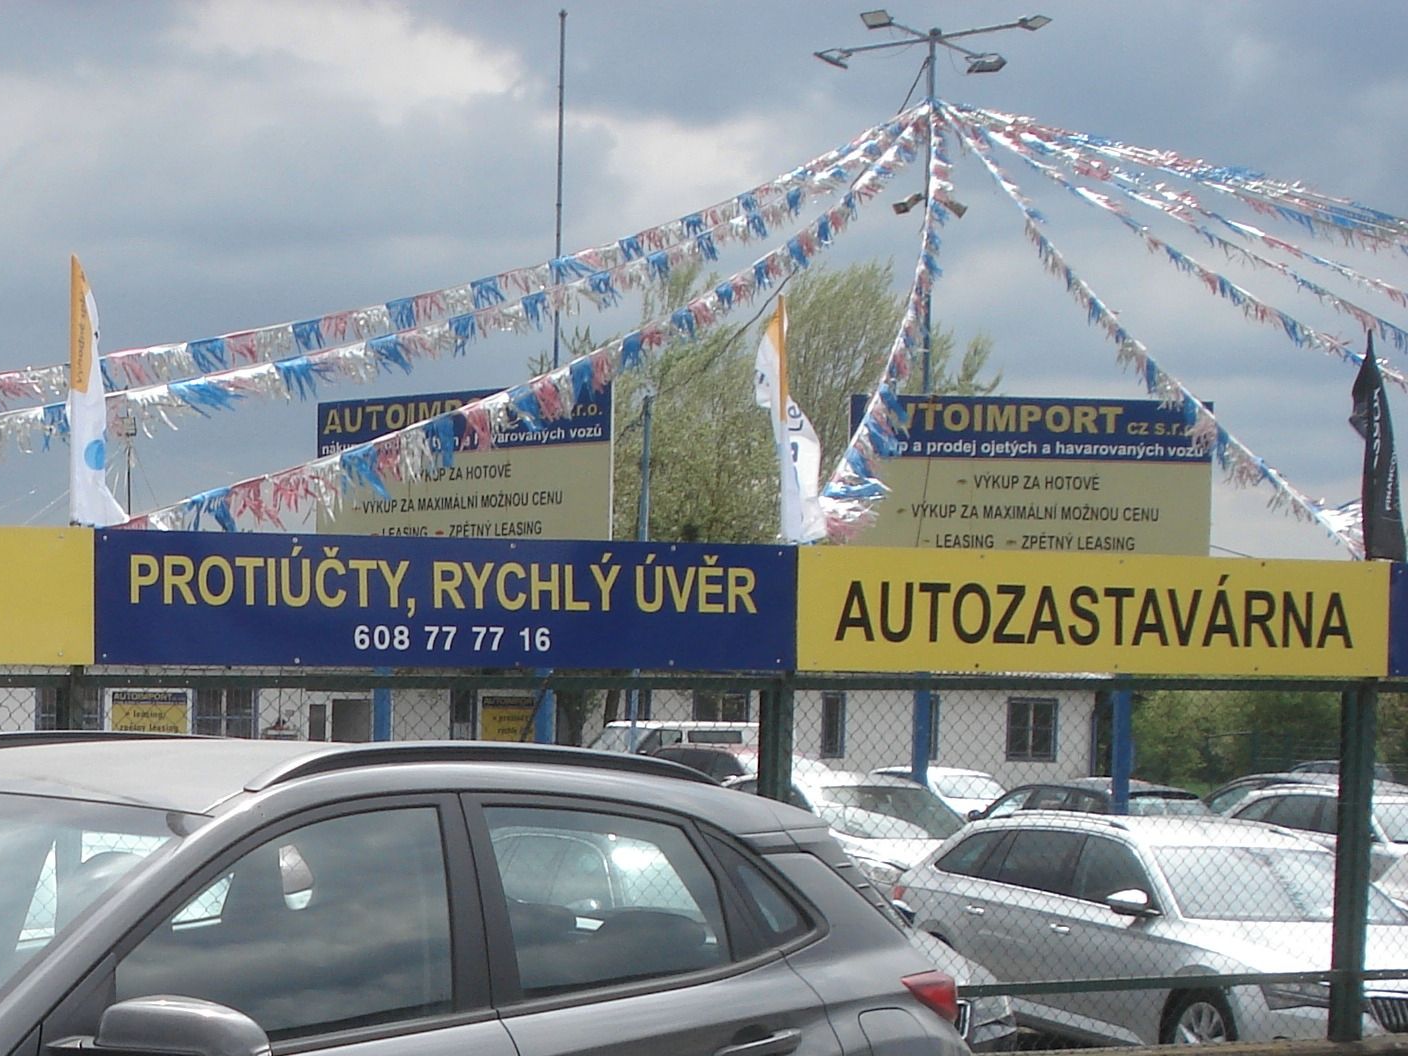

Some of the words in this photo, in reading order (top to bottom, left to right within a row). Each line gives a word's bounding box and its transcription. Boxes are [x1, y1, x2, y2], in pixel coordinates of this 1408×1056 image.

[1127, 422, 1149, 435] cz
[912, 441, 922, 452] a
[927, 439, 977, 455] prodej
[981, 440, 1038, 456] ojetých
[1041, 444, 1051, 455] a
[1055, 441, 1164, 459] havarovaných
[448, 466, 463, 481] ZA
[466, 462, 511, 479] HOTOVÉ
[974, 472, 1019, 490] VÝKUP
[1023, 475, 1040, 490] ZA
[1044, 472, 1100, 491] HOTOVÉ
[400, 498, 415, 513] ZA
[418, 491, 478, 511] MAXIMÁLNÍ
[481, 490, 529, 508] MOŽNOU
[532, 491, 563, 506] CENU
[911, 501, 957, 518] VÝKUP
[960, 504, 979, 519] ZA
[983, 501, 1058, 520] MAXIMÁLNÍ
[1061, 502, 1119, 521] MOŽNOU
[1122, 507, 1160, 522] CENU
[494, 520, 542, 536] LEASING
[935, 534, 995, 549] LEASING
[1021, 531, 1073, 550] ZPĚTNÝ
[1077, 536, 1136, 551] LEASING
[130, 545, 416, 618] PROTIÚČTY,
[433, 552, 620, 612] RYCHLÝ
[636, 553, 757, 614] ÚVĚR
[834, 574, 1354, 649] AUTOZASTAVÁRNA
[353, 624, 410, 651] 608
[424, 625, 456, 651] 77
[472, 626, 504, 652] 77
[519, 626, 551, 652] 16
